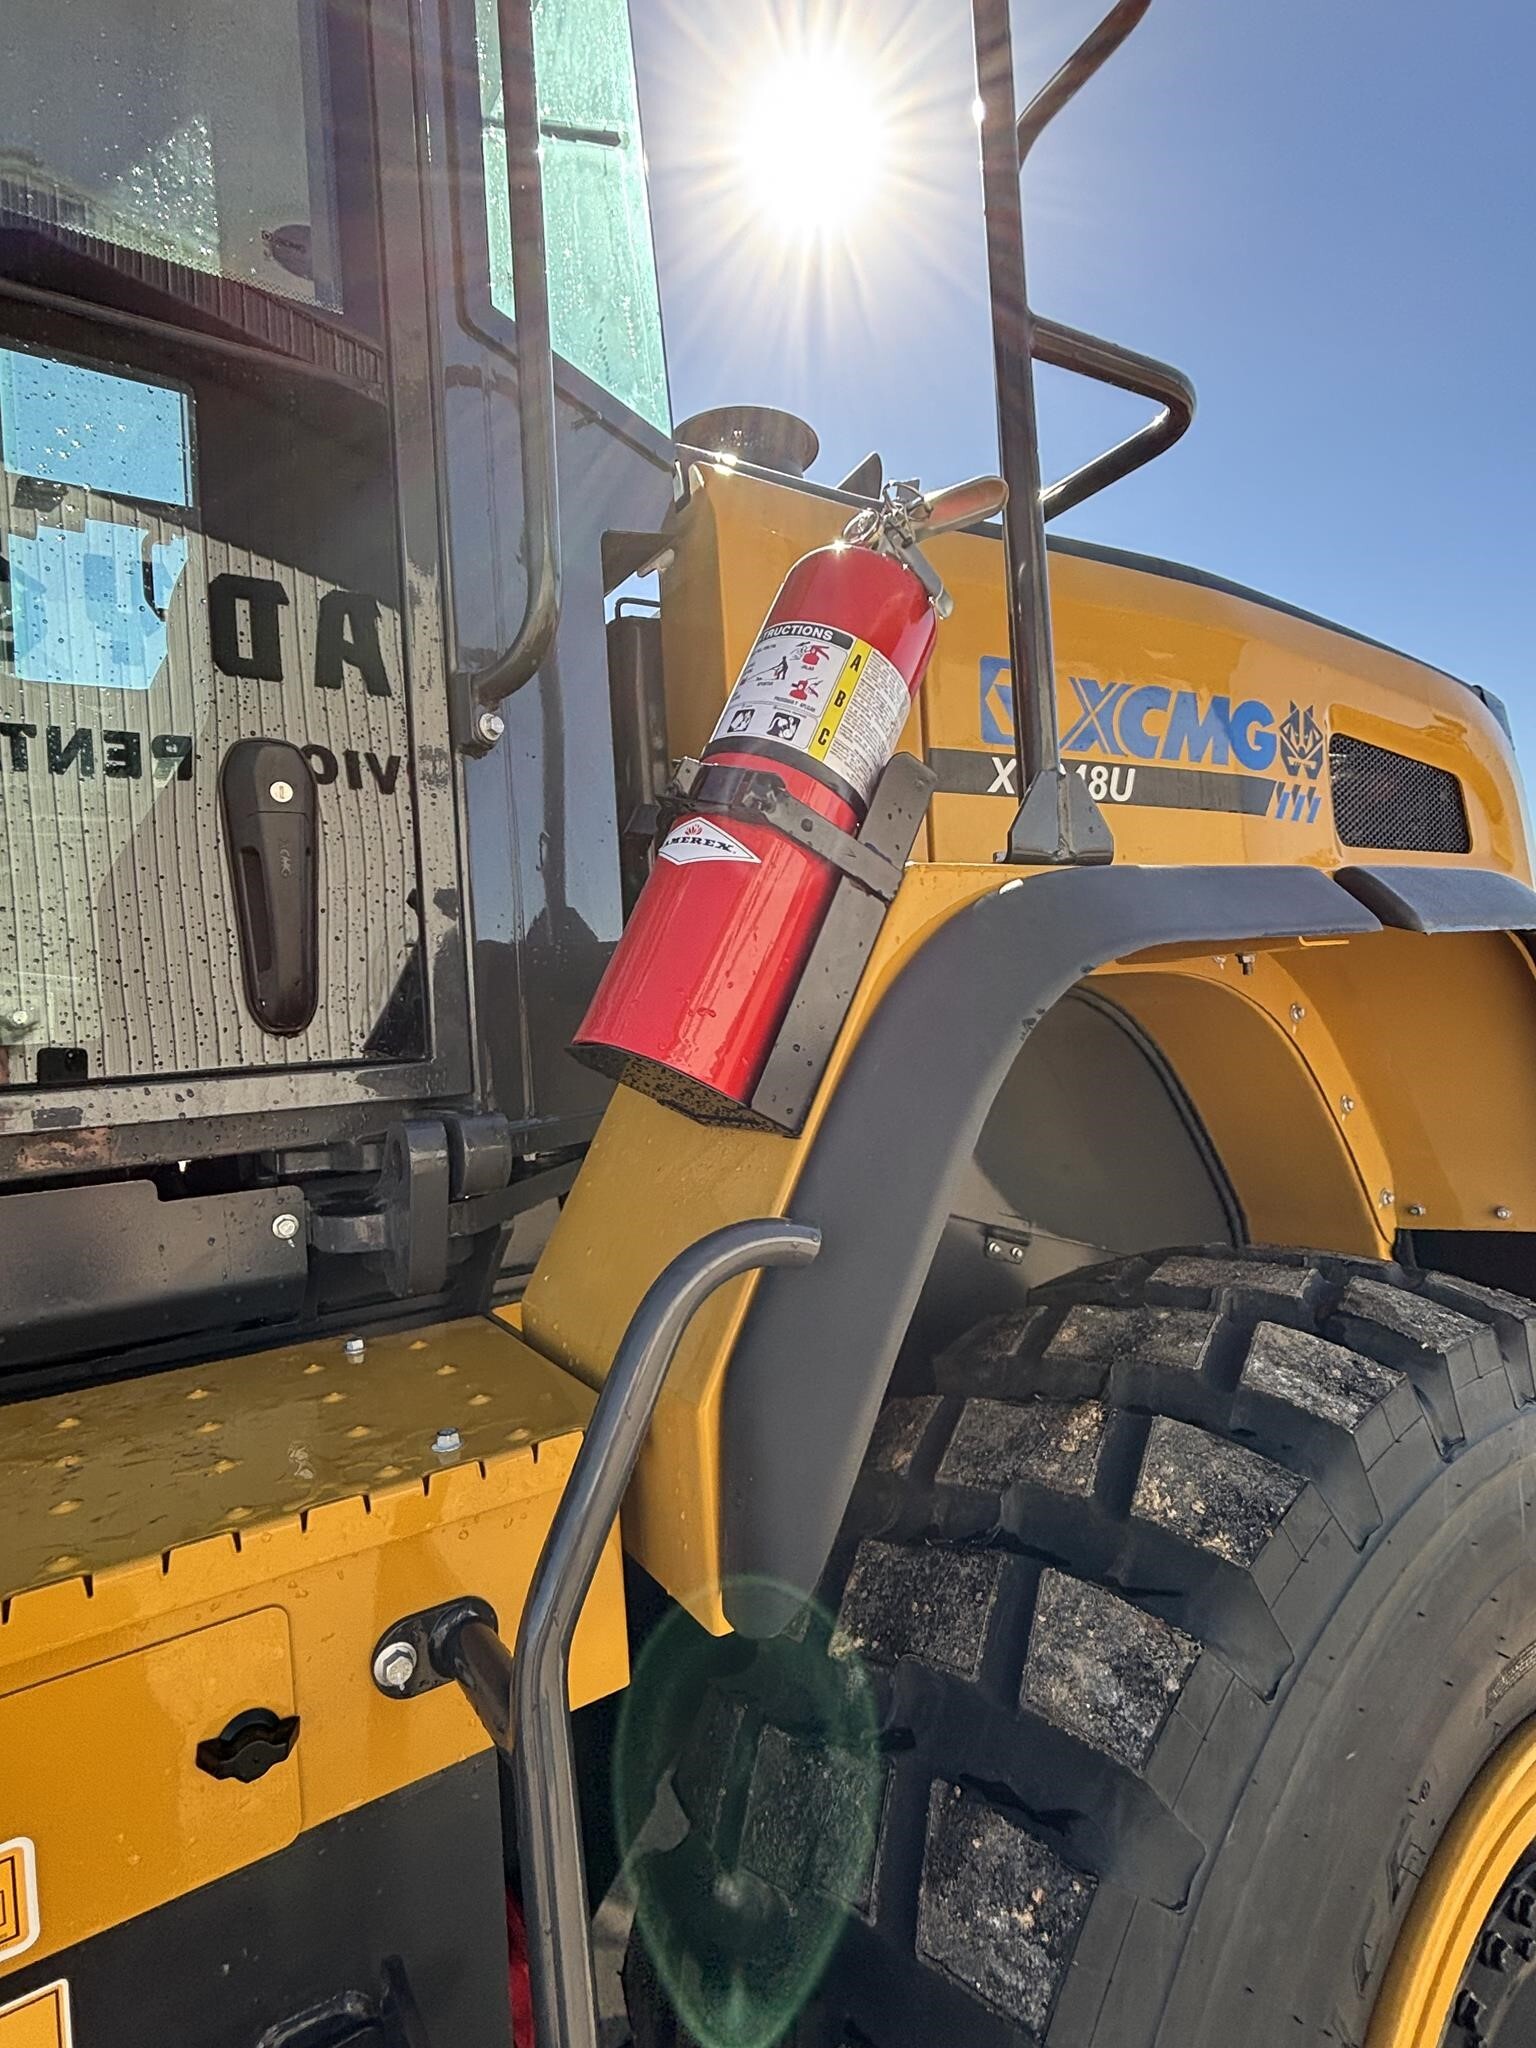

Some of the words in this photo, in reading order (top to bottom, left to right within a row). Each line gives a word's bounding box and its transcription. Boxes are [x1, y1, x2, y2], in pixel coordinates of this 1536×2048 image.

[762, 625, 834, 641] TRUCTIONS
[850, 654, 862, 673] A
[834, 690, 847, 708] B
[1060, 676, 1278, 771] XCMG
[817, 728, 831, 746] C
